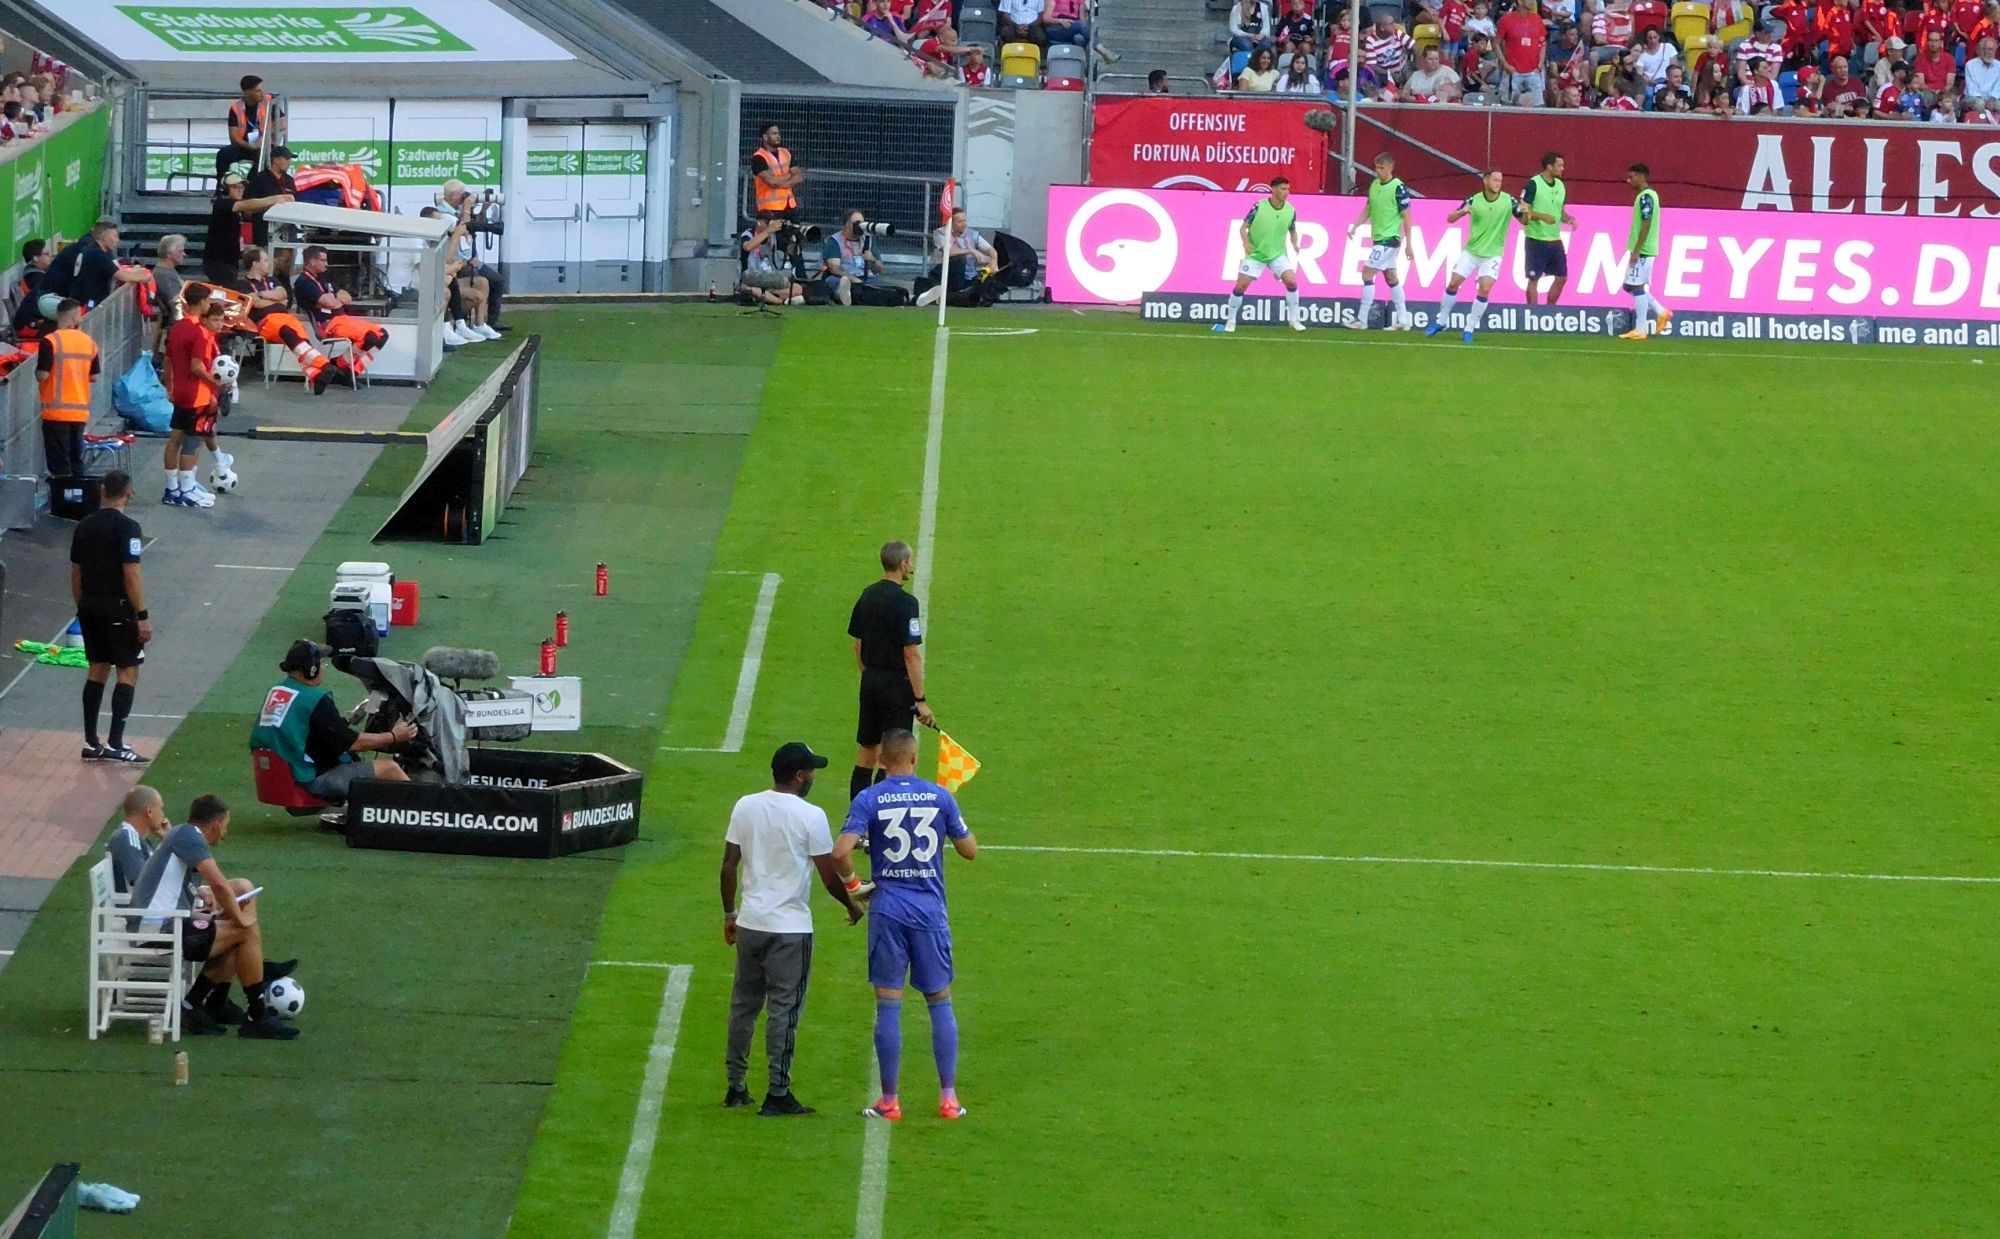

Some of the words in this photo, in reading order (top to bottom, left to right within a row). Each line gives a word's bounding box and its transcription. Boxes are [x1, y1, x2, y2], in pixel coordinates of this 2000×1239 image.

[140, 11, 325, 29] Stadtwerke
[166, 28, 349, 47] Düsseldorf
[1169, 112, 1246, 132] OFFENSIVE
[291, 148, 346, 162] dtwerke
[397, 148, 460, 162] Stadtwerke
[1133, 144, 1200, 162] FORTUNA
[1206, 142, 1296, 165] DÜSSELDORF
[397, 163, 460, 178] Düsseldorf
[1740, 134, 2000, 218] ALLES
[1144, 301, 1182, 319] me
[1241, 299, 1271, 321] all
[1279, 299, 1356, 324] hotels
[1487, 310, 1517, 332] all
[1524, 310, 1601, 332] hotels
[1679, 317, 1725, 338] and
[1731, 317, 1761, 338] all
[1768, 318, 1845, 341] hotels
[1878, 327, 1917, 344] me
[1923, 323, 1969, 345] and
[476, 708, 525, 718] BUNDESLIGA
[877, 792, 938, 804] DÜSSELDORF
[362, 807, 538, 833] BUNDESLIGA.COM
[572, 802, 634, 830] BUNDESLIGA
[877, 807, 940, 863] 33
